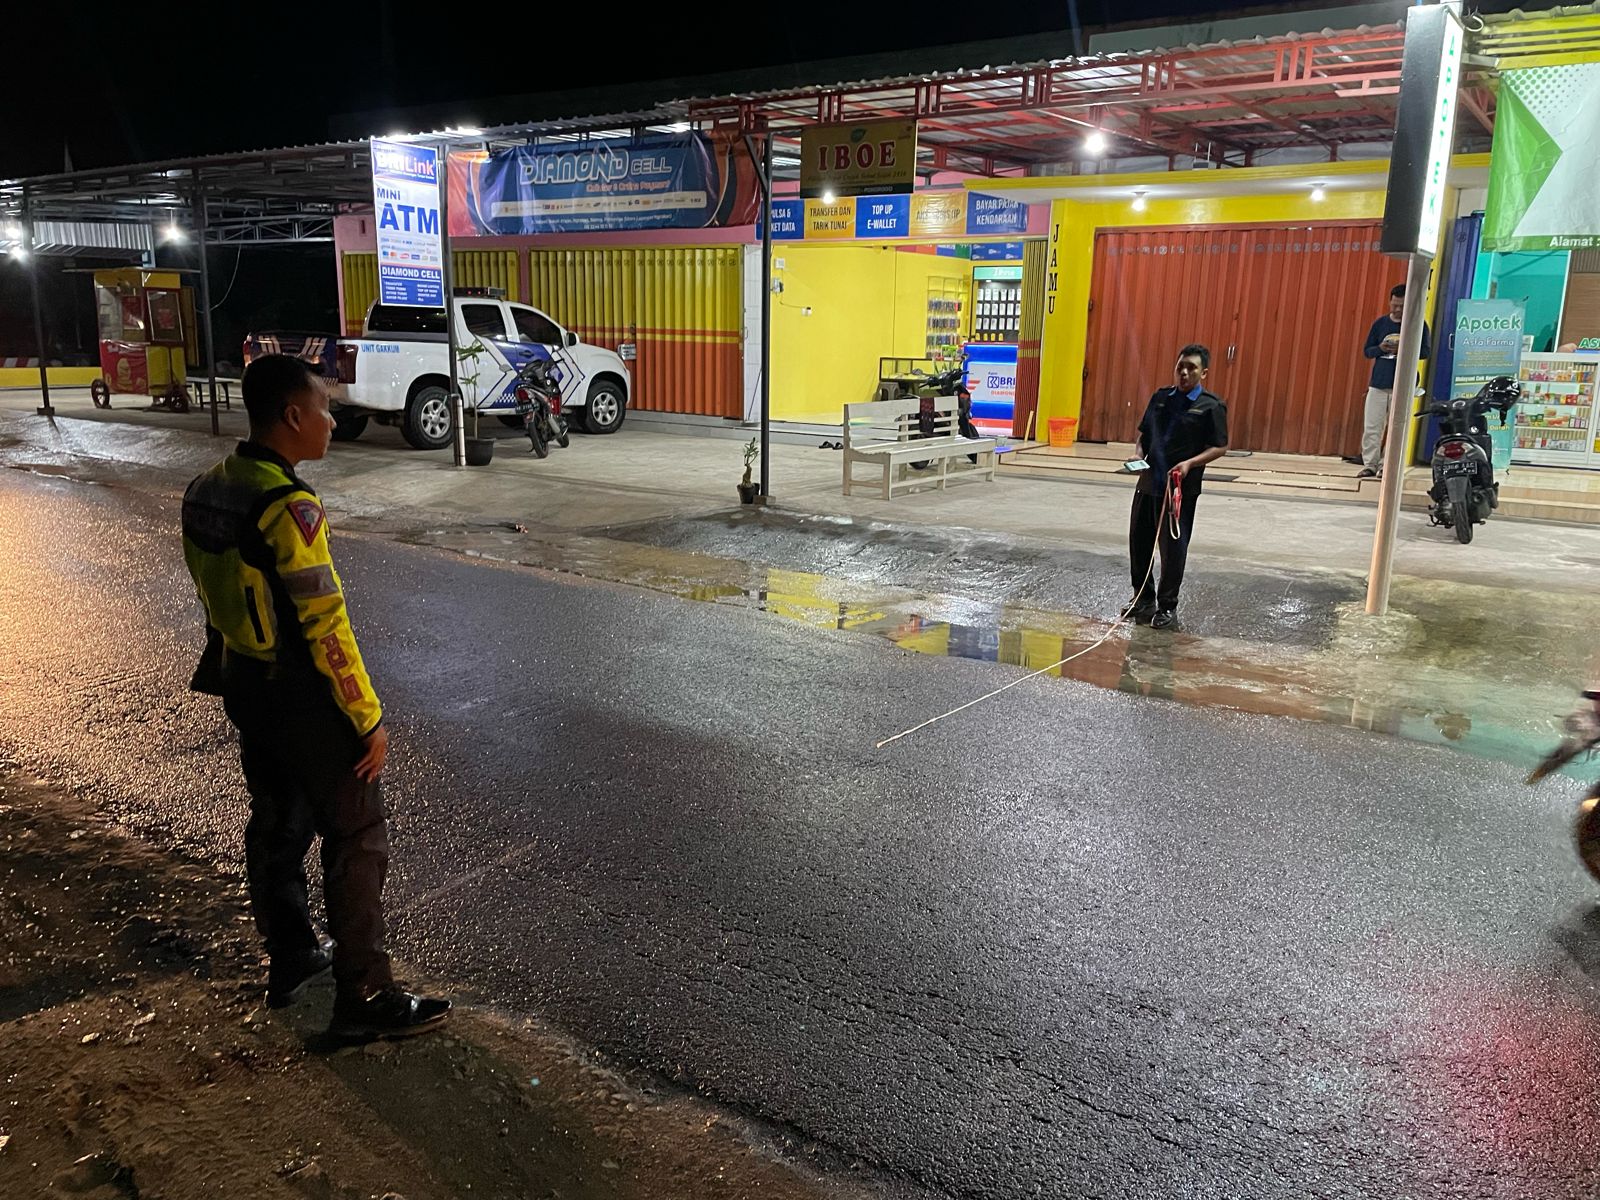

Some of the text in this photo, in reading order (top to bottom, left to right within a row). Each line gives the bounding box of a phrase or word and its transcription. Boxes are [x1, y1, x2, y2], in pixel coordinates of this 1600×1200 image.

[817, 141, 897, 172] IBOE
[518, 148, 673, 185] DIAMOND CELL
[377, 187, 401, 200] MINI
[872, 204, 894, 215] TOP UP
[975, 199, 998, 210] BAYAR
[787, 208, 792, 218] &
[810, 206, 851, 217] TRANSFER DAN
[379, 202, 439, 235] ATM
[867, 218, 897, 230] E-WALLET
[976, 213, 1017, 225] KENDARAAN
[781, 222, 796, 232] DATA
[813, 220, 848, 231] TARIK TUNAI
[1549, 235, 1594, 247] Alamat
[382, 266, 441, 280] DIAMOND CELL
[1048, 224, 1060, 315] JAMU
[1458, 313, 1521, 334] Apotek
[1463, 337, 1514, 346] Asta Farma
[361, 343, 375, 353] UNIT
[1000, 377, 1016, 386] BRI
